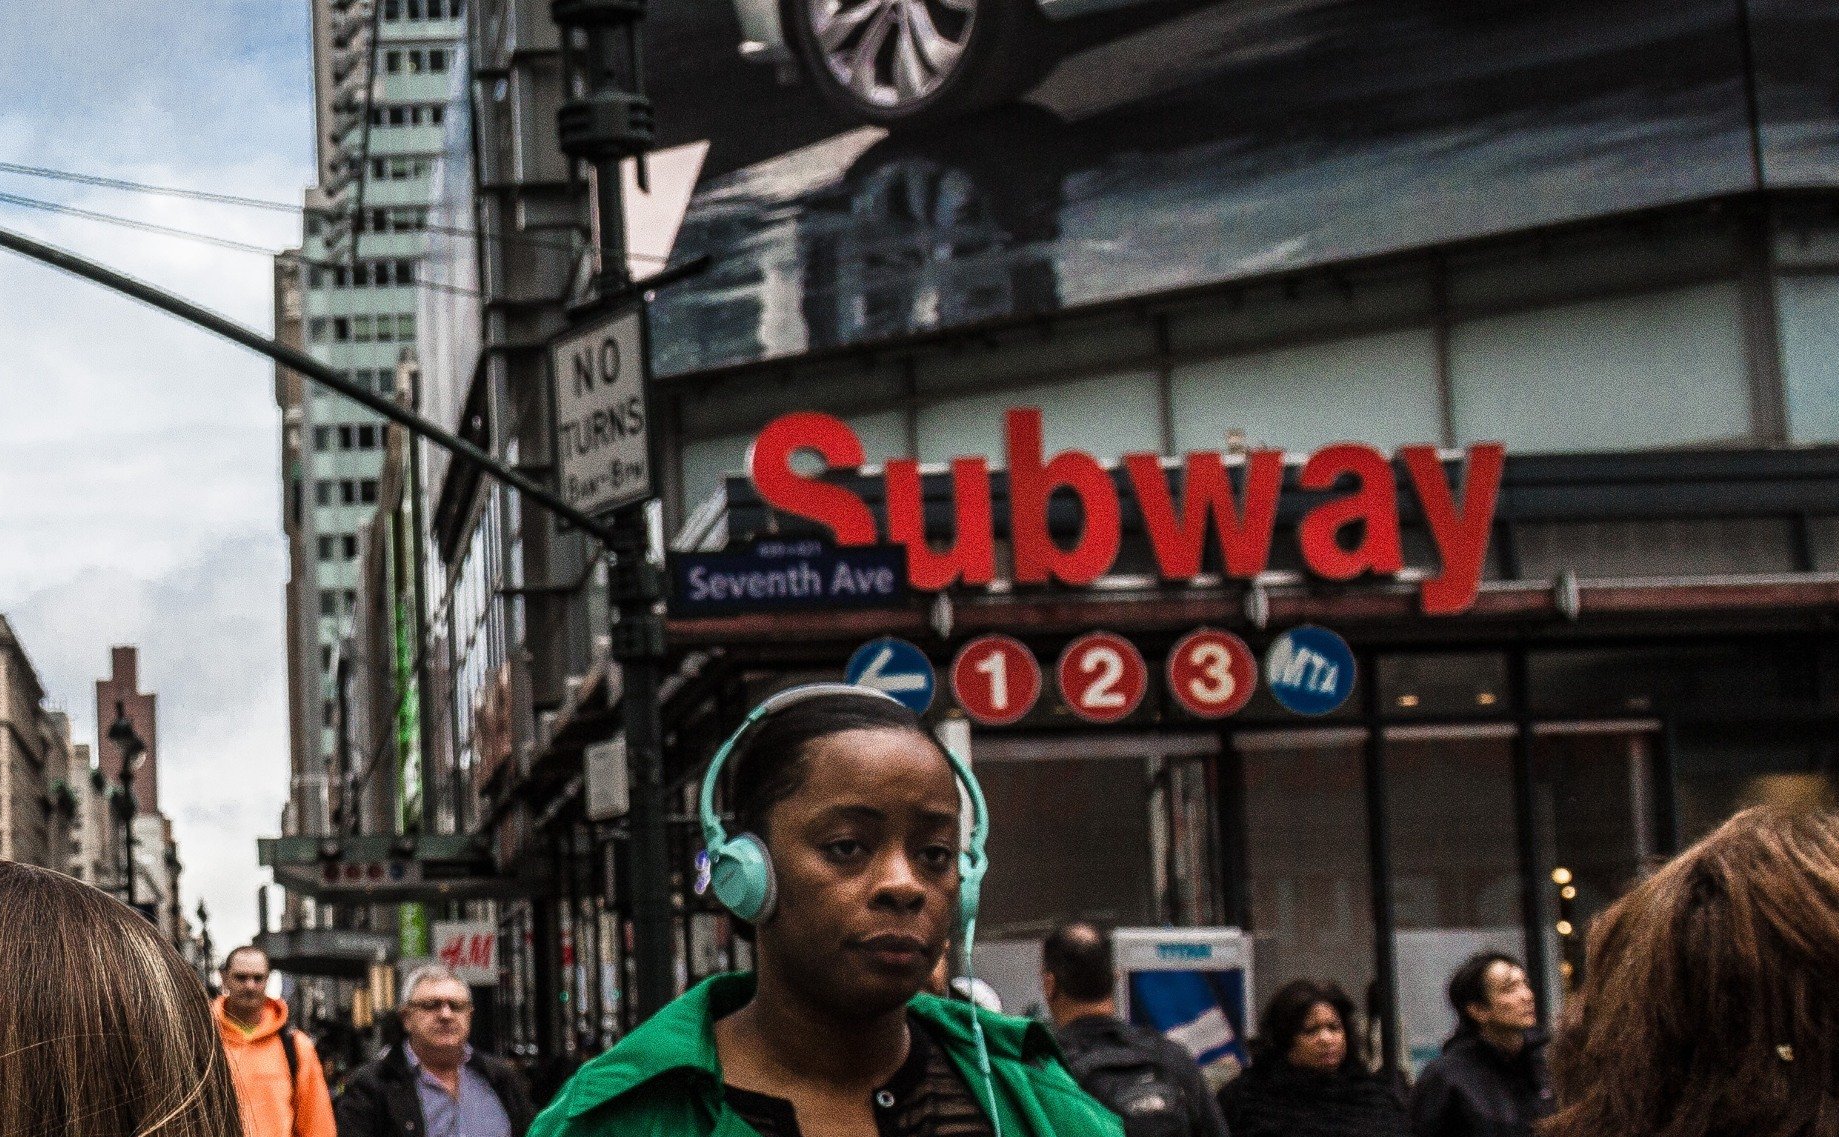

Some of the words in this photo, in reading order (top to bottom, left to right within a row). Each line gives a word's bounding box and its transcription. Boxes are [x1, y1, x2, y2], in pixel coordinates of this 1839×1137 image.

[572, 336, 621, 398] NO
[559, 397, 644, 460] TURNS
[750, 407, 1505, 615] Subway
[687, 561, 822, 601] Seventh
[830, 561, 895, 595] Ave
[976, 652, 1008, 709] 1
[1081, 648, 1126, 708] 2
[1188, 644, 1234, 703] 3
[1267, 636, 1339, 695] MTA
